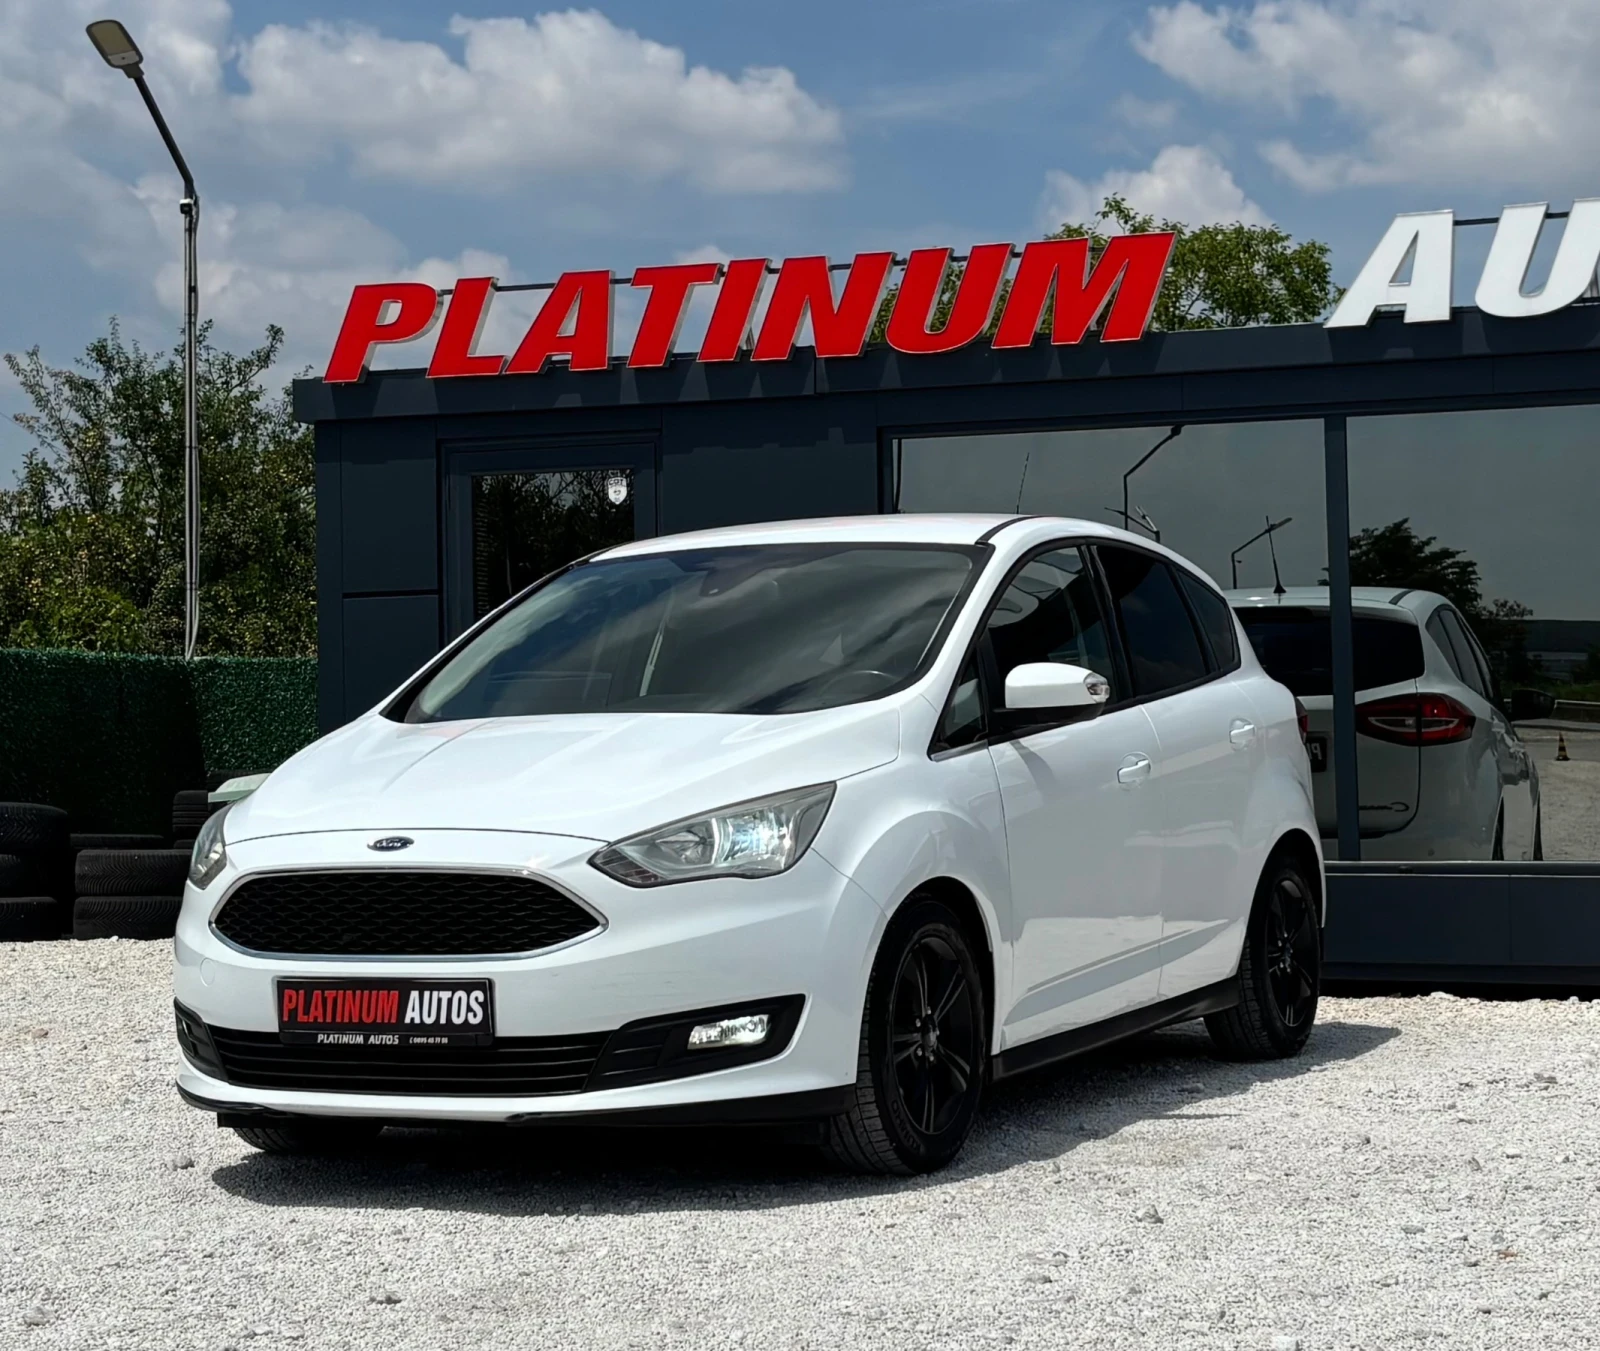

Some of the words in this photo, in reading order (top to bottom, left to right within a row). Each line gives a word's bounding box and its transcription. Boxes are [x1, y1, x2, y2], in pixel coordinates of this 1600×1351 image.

[323, 231, 1177, 384] PLATINUM
[1323, 197, 1600, 328] AU
[283, 989, 399, 1022] PLATINUM
[404, 990, 484, 1024] AUTOS
[317, 1033, 364, 1044] PLATINUM
[368, 1034, 399, 1045] AUTOS
